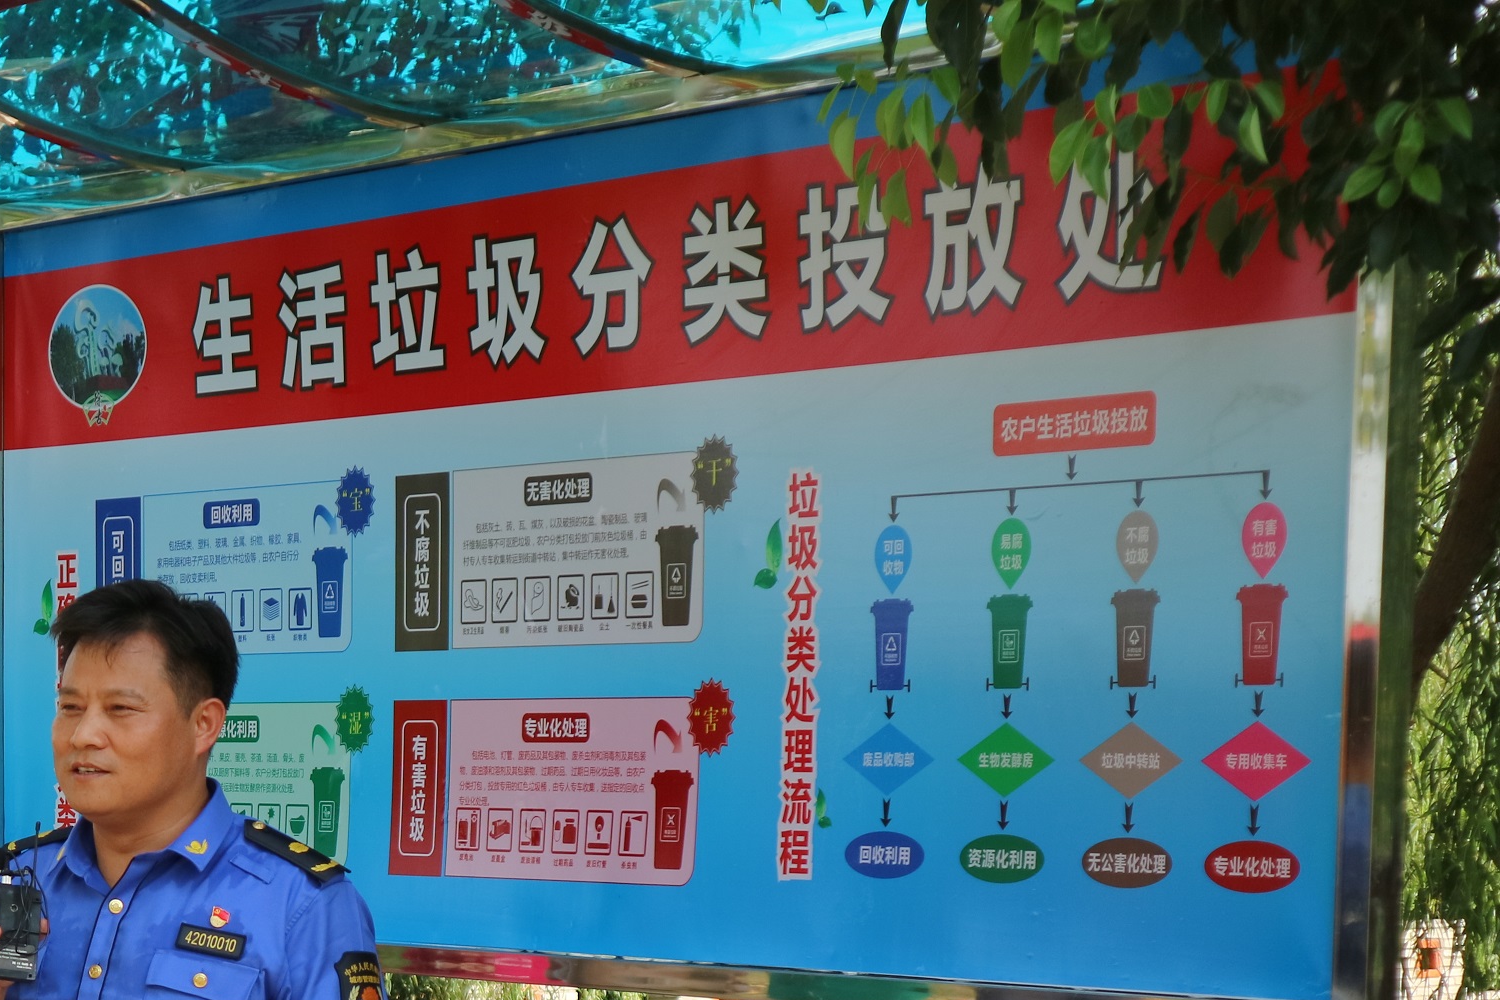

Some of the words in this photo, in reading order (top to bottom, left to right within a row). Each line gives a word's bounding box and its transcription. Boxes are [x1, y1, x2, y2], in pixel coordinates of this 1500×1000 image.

[192, 150, 1164, 396] 生活垃圾分类投放处
[1000, 406, 1149, 443] 农户生活垃圾投放
[526, 477, 591, 502] 无害化处理
[210, 503, 253, 525] 回收利用
[1125, 525, 1150, 544] 不腐
[1252, 518, 1278, 537] 有害
[882, 538, 905, 556] 可回
[999, 531, 1023, 550] 易腐
[1251, 541, 1277, 560] 垃圾
[111, 530, 126, 585] 可回
[413, 508, 431, 618] 不腐垃圾
[999, 553, 1023, 571] 垃圾
[1124, 547, 1149, 566] 垃圾
[882, 558, 905, 577] 收物
[779, 472, 819, 876] 垃圾分类处理流程
[524, 718, 588, 738] 专业化处理
[862, 751, 915, 768] 废品收购部
[978, 751, 1034, 769] 生物发酵房
[1101, 752, 1160, 770] 垃圾中转站
[1225, 752, 1288, 771] 专用收集车
[409, 735, 427, 843] 有害垃圾
[858, 845, 911, 865] 回收利用
[967, 848, 1037, 869] 资源化利用
[1087, 853, 1167, 875] 无公害化处理
[1214, 856, 1291, 878] 专业化处理
[184, 930, 237, 953] 42010010
